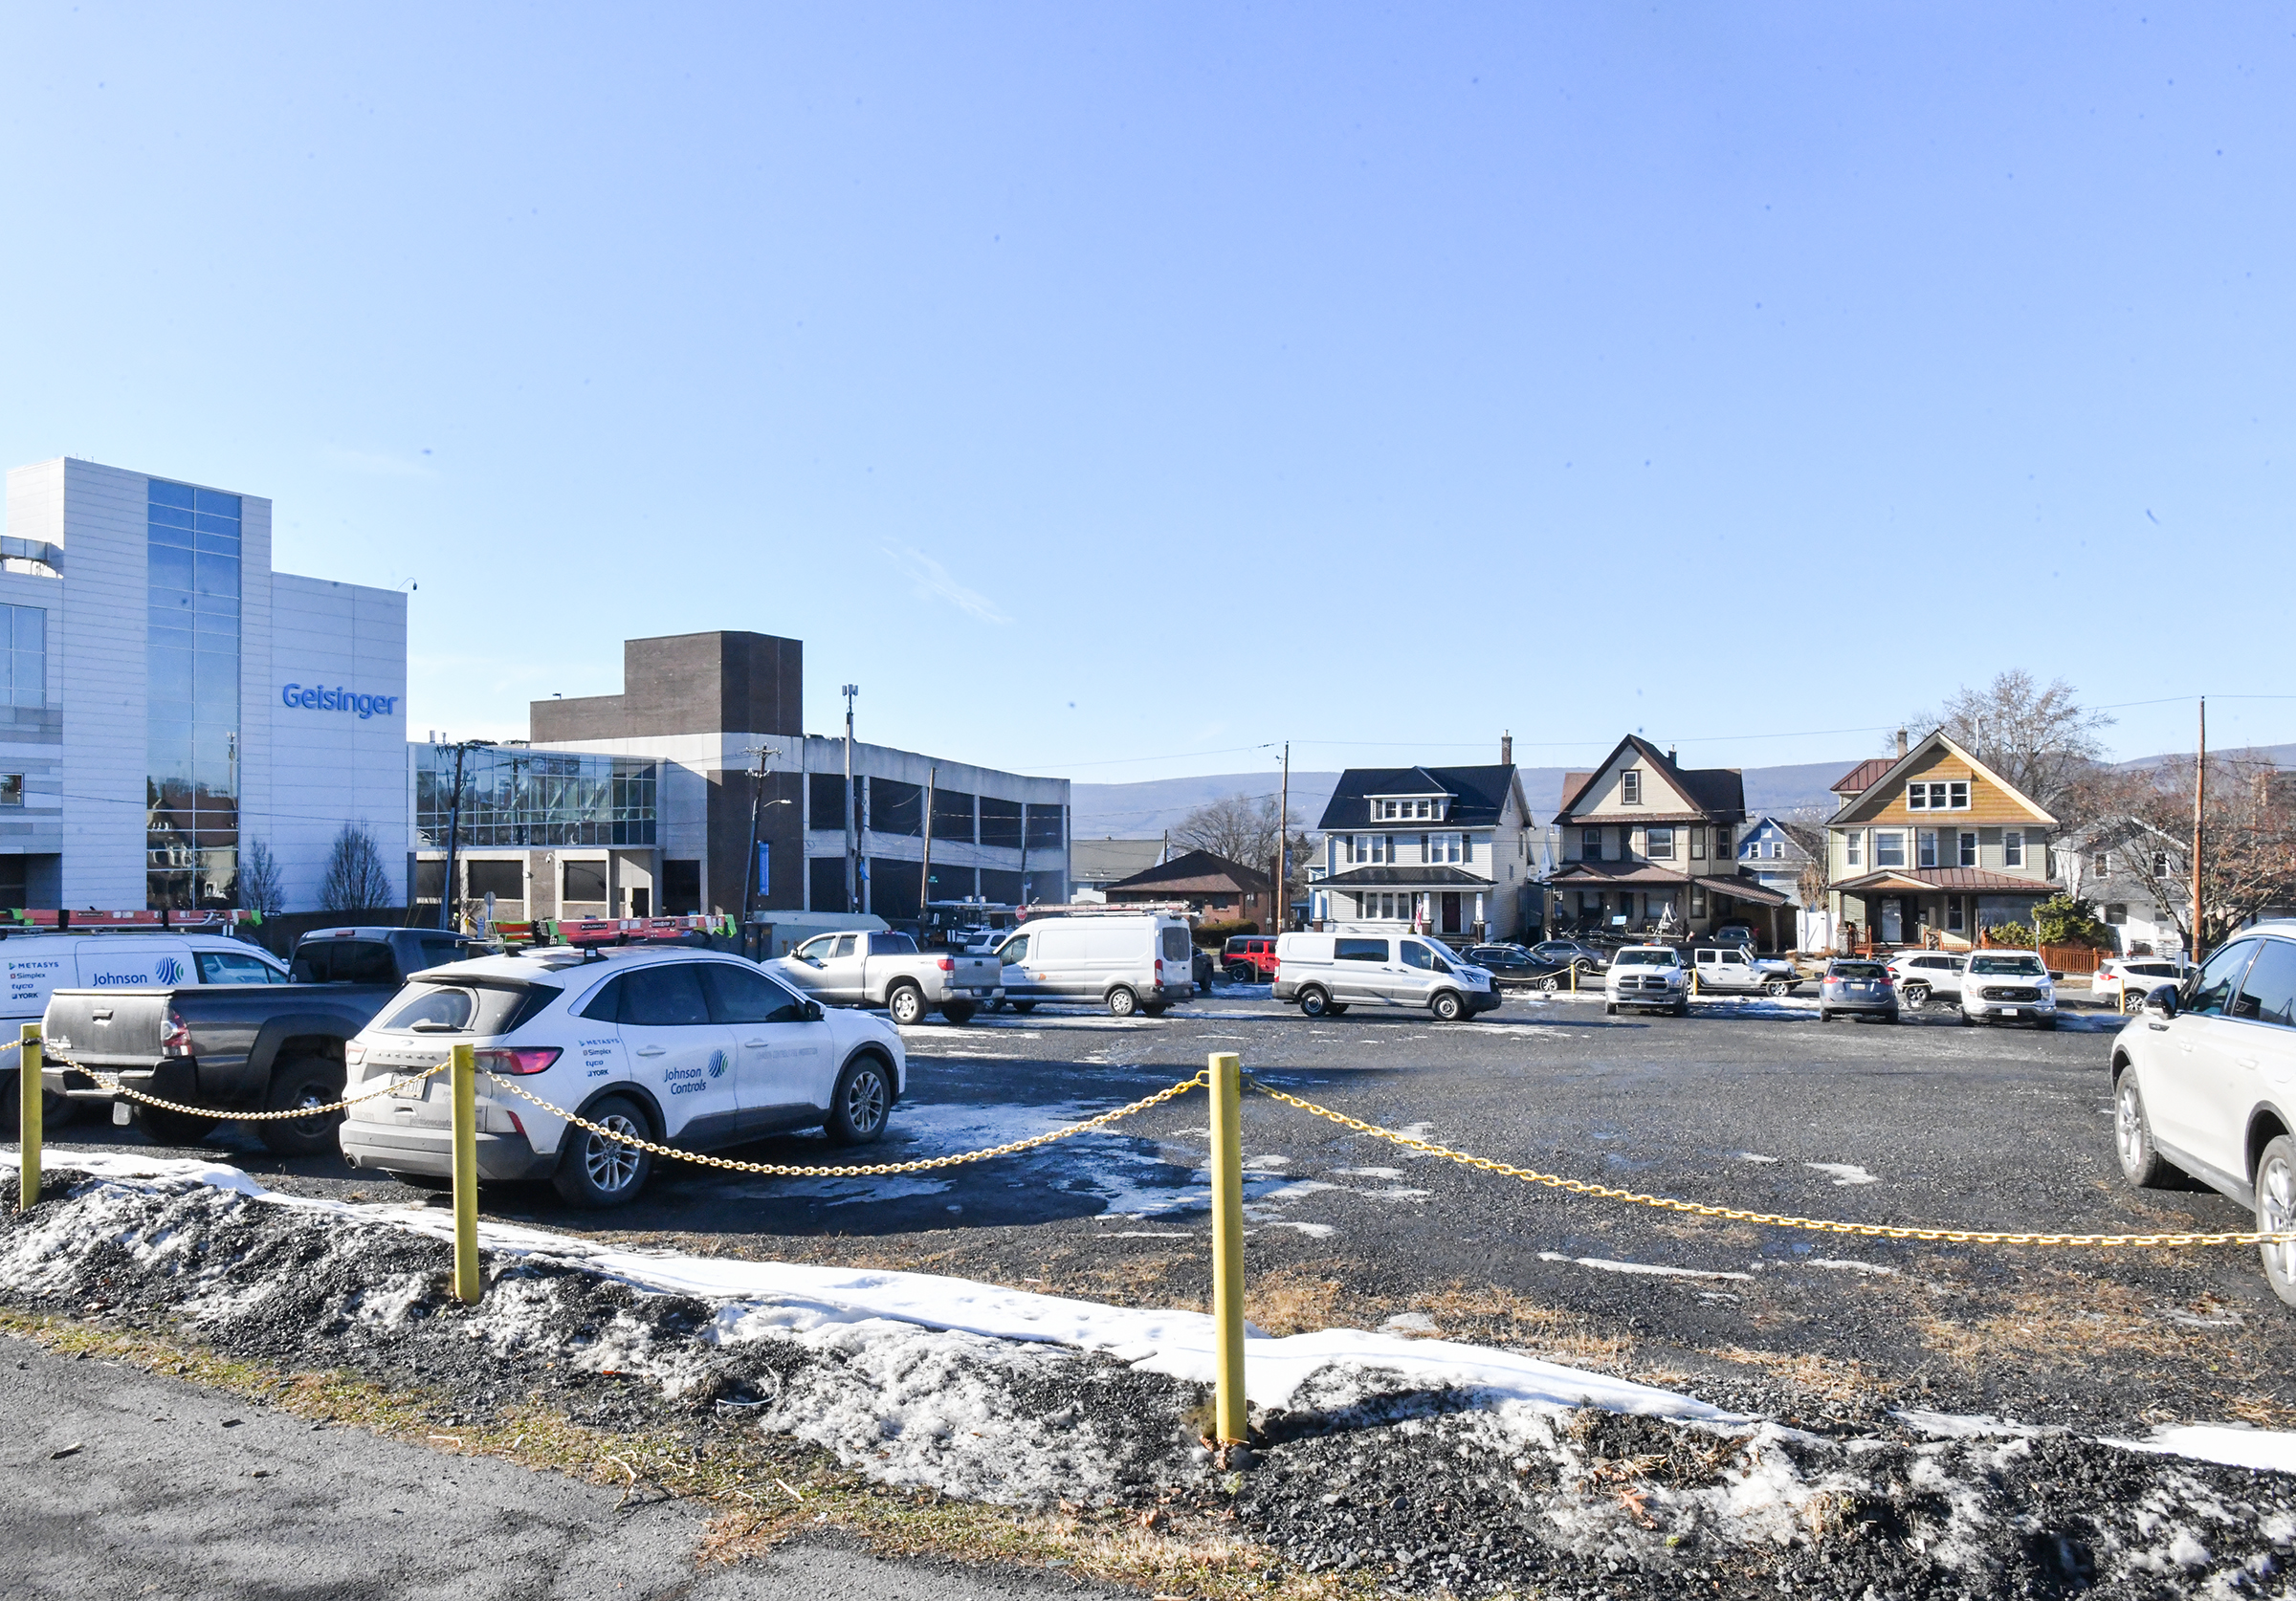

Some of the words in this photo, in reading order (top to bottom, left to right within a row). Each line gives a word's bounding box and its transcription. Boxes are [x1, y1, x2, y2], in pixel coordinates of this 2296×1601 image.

[283, 683, 398, 719] Geisinger
[93, 972, 147, 987] Johnson
[664, 1067, 702, 1083] Johnson
[671, 1079, 707, 1095] Controls
